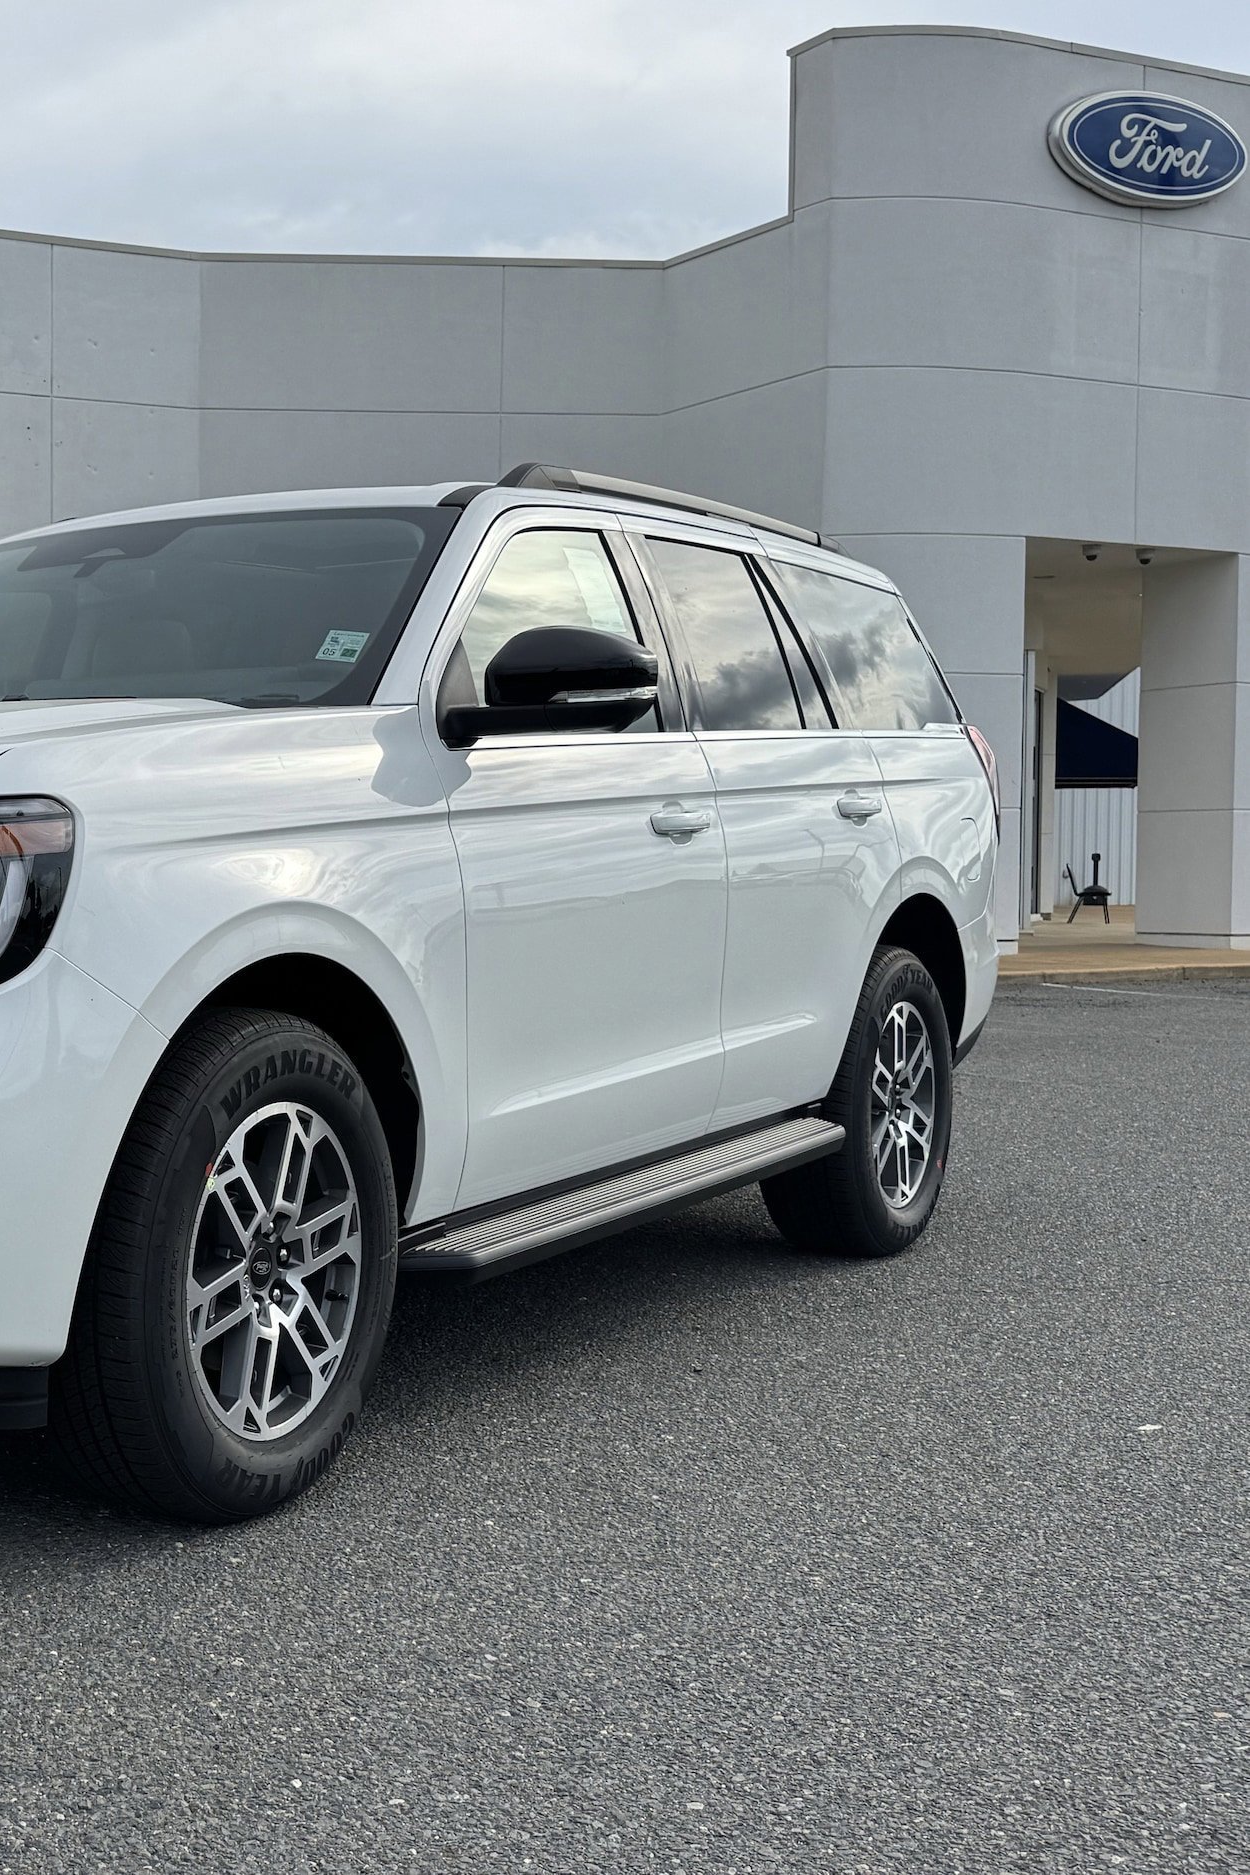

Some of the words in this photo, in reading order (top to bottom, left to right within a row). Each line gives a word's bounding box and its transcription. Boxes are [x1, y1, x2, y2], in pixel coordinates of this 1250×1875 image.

[1109, 113, 1212, 180] Ford
[322, 647, 337, 656] 05
[219, 1048, 357, 1121] WRANGLER
